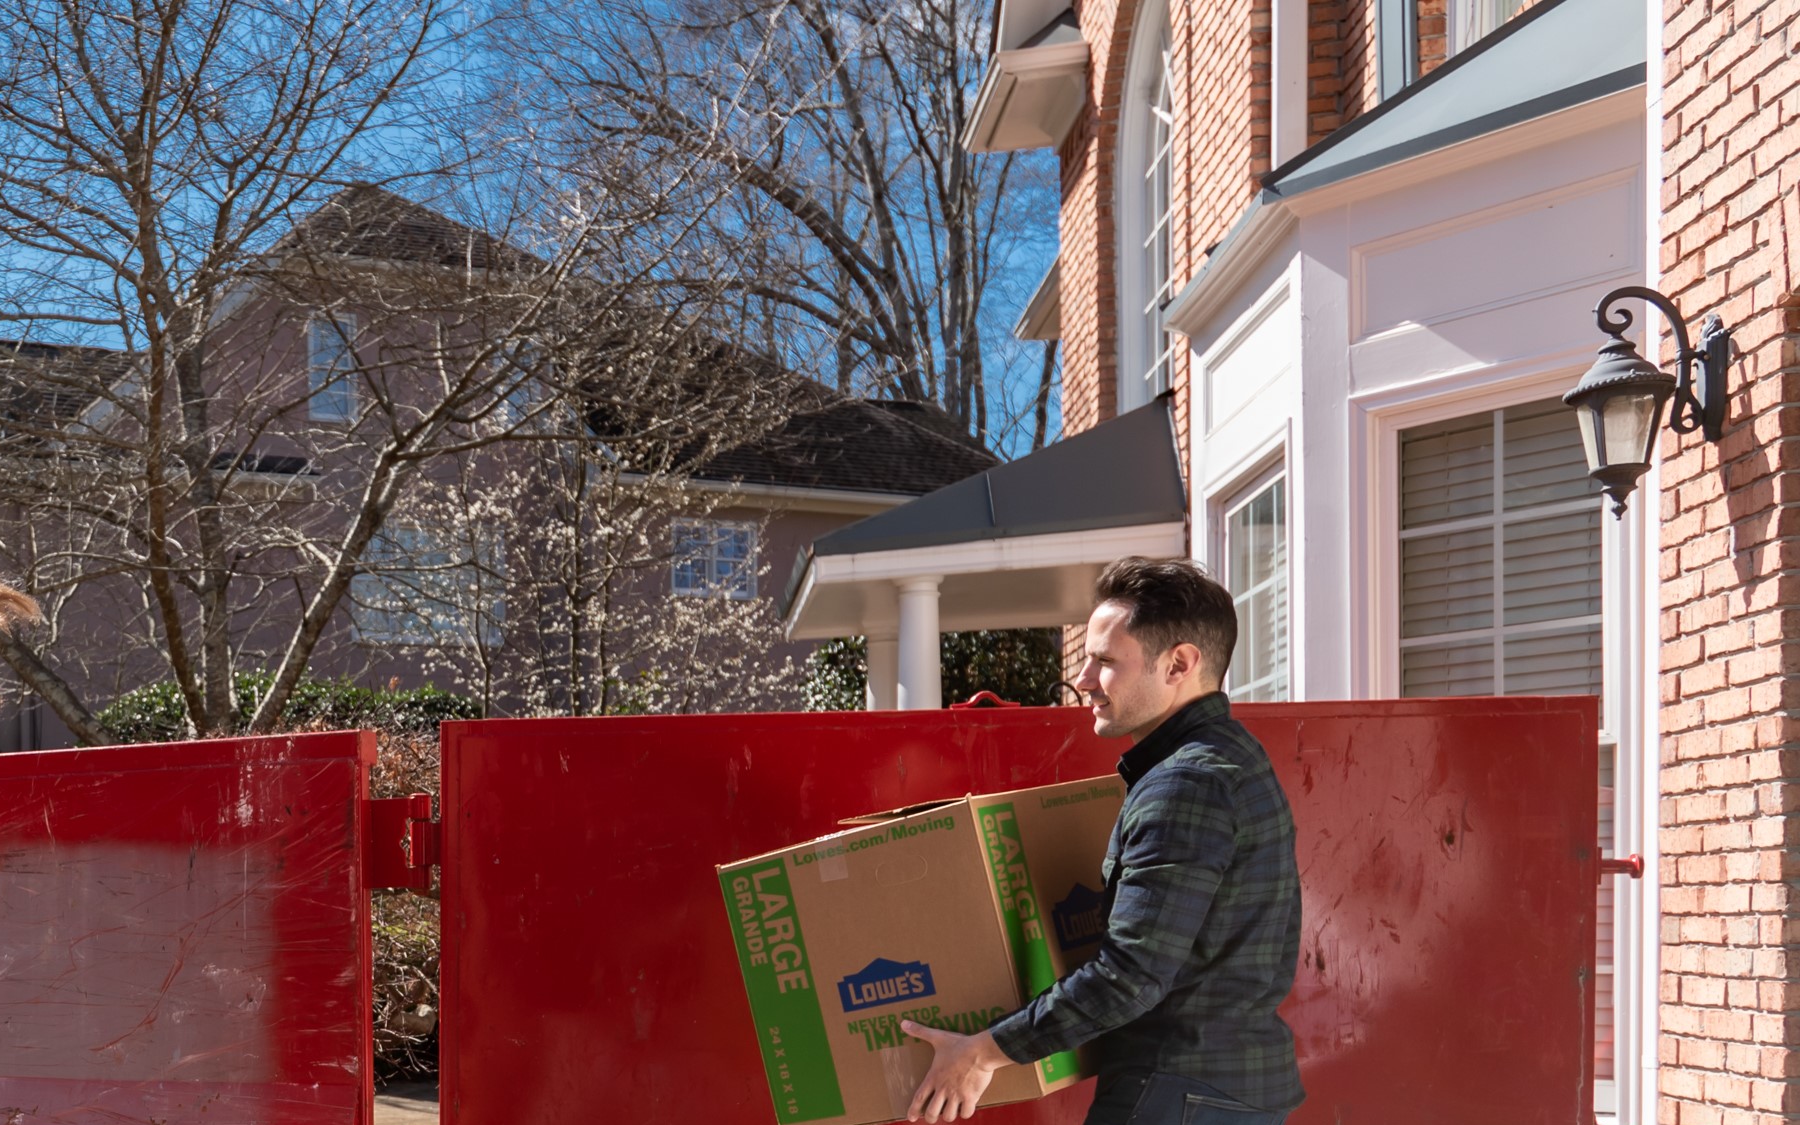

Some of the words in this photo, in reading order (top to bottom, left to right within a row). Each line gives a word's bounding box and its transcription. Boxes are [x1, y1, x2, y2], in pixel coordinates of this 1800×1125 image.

[1040, 785, 1121, 809] Lowes.com/Moving
[793, 814, 956, 867] Lowes.com/Moving
[982, 815, 1015, 913] GRANDE
[995, 810, 1042, 943] LARGE
[732, 876, 769, 967] GRANDE
[751, 866, 810, 994] LARGE
[1059, 902, 1103, 942] LOWE'
[848, 971, 925, 1006] LOWE'S
[769, 1026, 782, 1045] 24
[848, 1014, 897, 1035] NEVER
[901, 1005, 940, 1022] STOP
[775, 1049, 786, 1058] X
[778, 1063, 791, 1079] 18
[782, 1084, 794, 1093] X
[787, 1100, 799, 1115] 18
